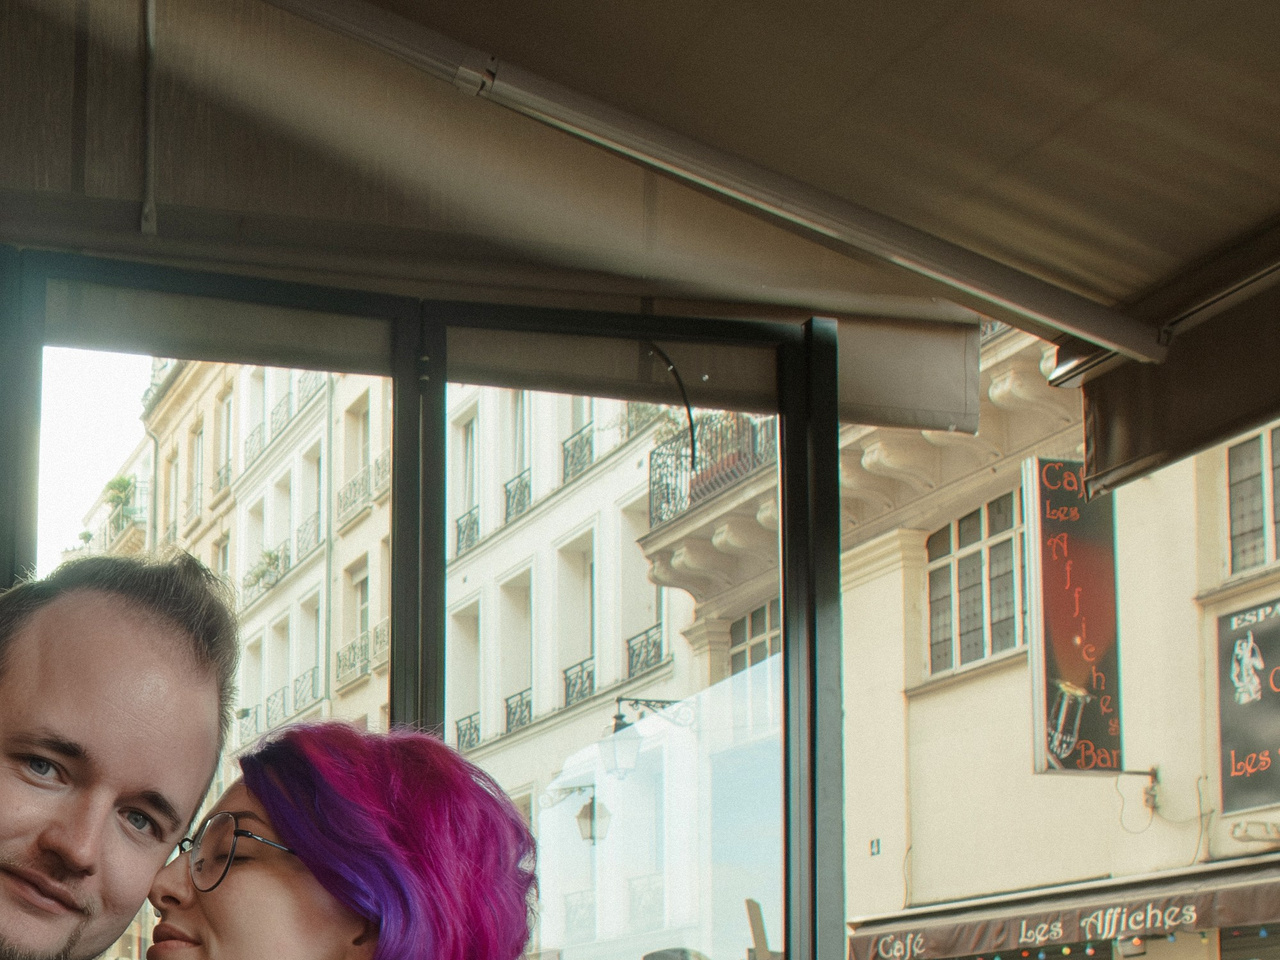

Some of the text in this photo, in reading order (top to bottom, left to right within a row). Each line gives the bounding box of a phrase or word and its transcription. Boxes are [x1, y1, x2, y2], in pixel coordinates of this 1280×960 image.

[1046, 499, 1080, 522] Les
[1076, 740, 1120, 770] Bar
[1230, 750, 1272, 777] Les
[878, 902, 1197, 960] Café Les Affiches
